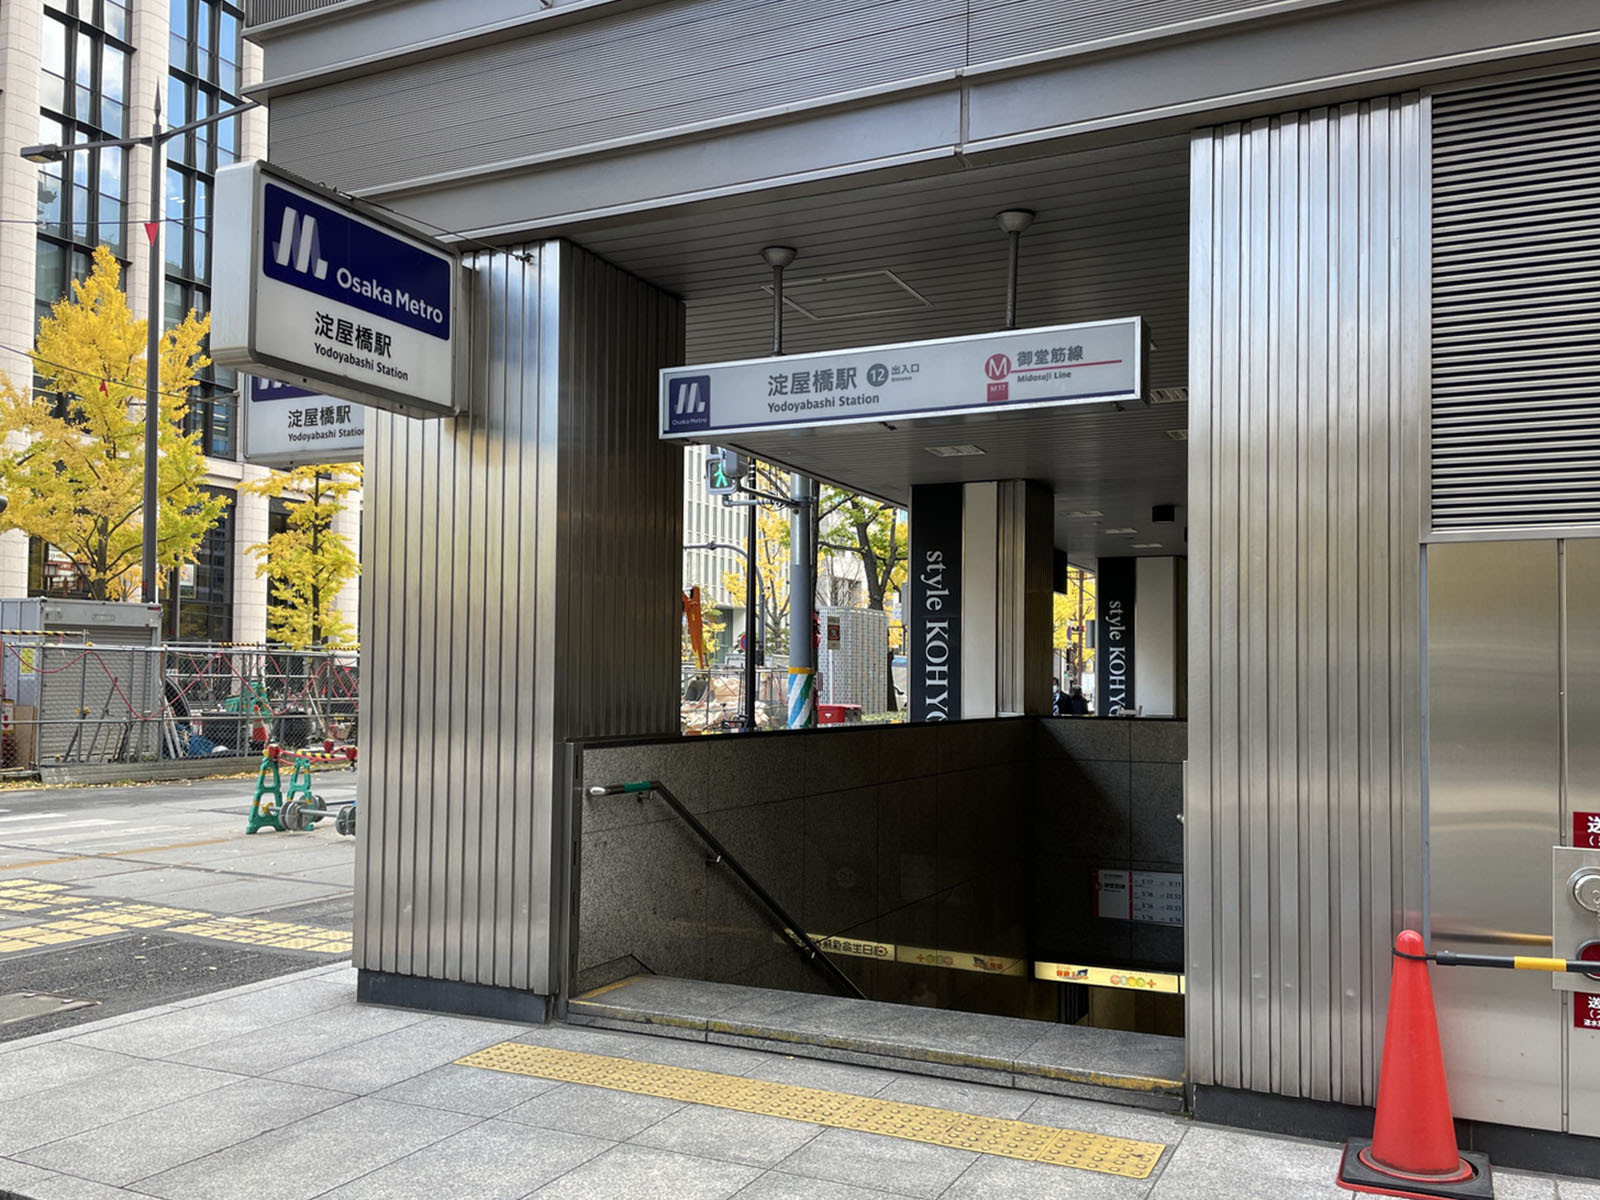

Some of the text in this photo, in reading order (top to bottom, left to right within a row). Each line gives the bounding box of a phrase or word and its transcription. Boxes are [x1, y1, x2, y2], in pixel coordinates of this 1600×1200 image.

[337, 268, 444, 324] Osaka Metro
[314, 310, 392, 359] 淀屋橋駅
[314, 342, 409, 381] Yodoyabashi Station
[1017, 345, 1083, 367] 御堂筋線
[767, 366, 858, 397] 淀屋橋駅
[870, 369, 886, 382] 12
[891, 363, 920, 376] 出入口
[1017, 370, 1072, 382] Midosuji Line
[767, 393, 880, 414] Yodoyabashi Station
[287, 404, 351, 429] 淀屋橋駅
[287, 428, 337, 443] Yodoyabashi
[920, 551, 950, 611] style
[1105, 600, 1127, 641] style
